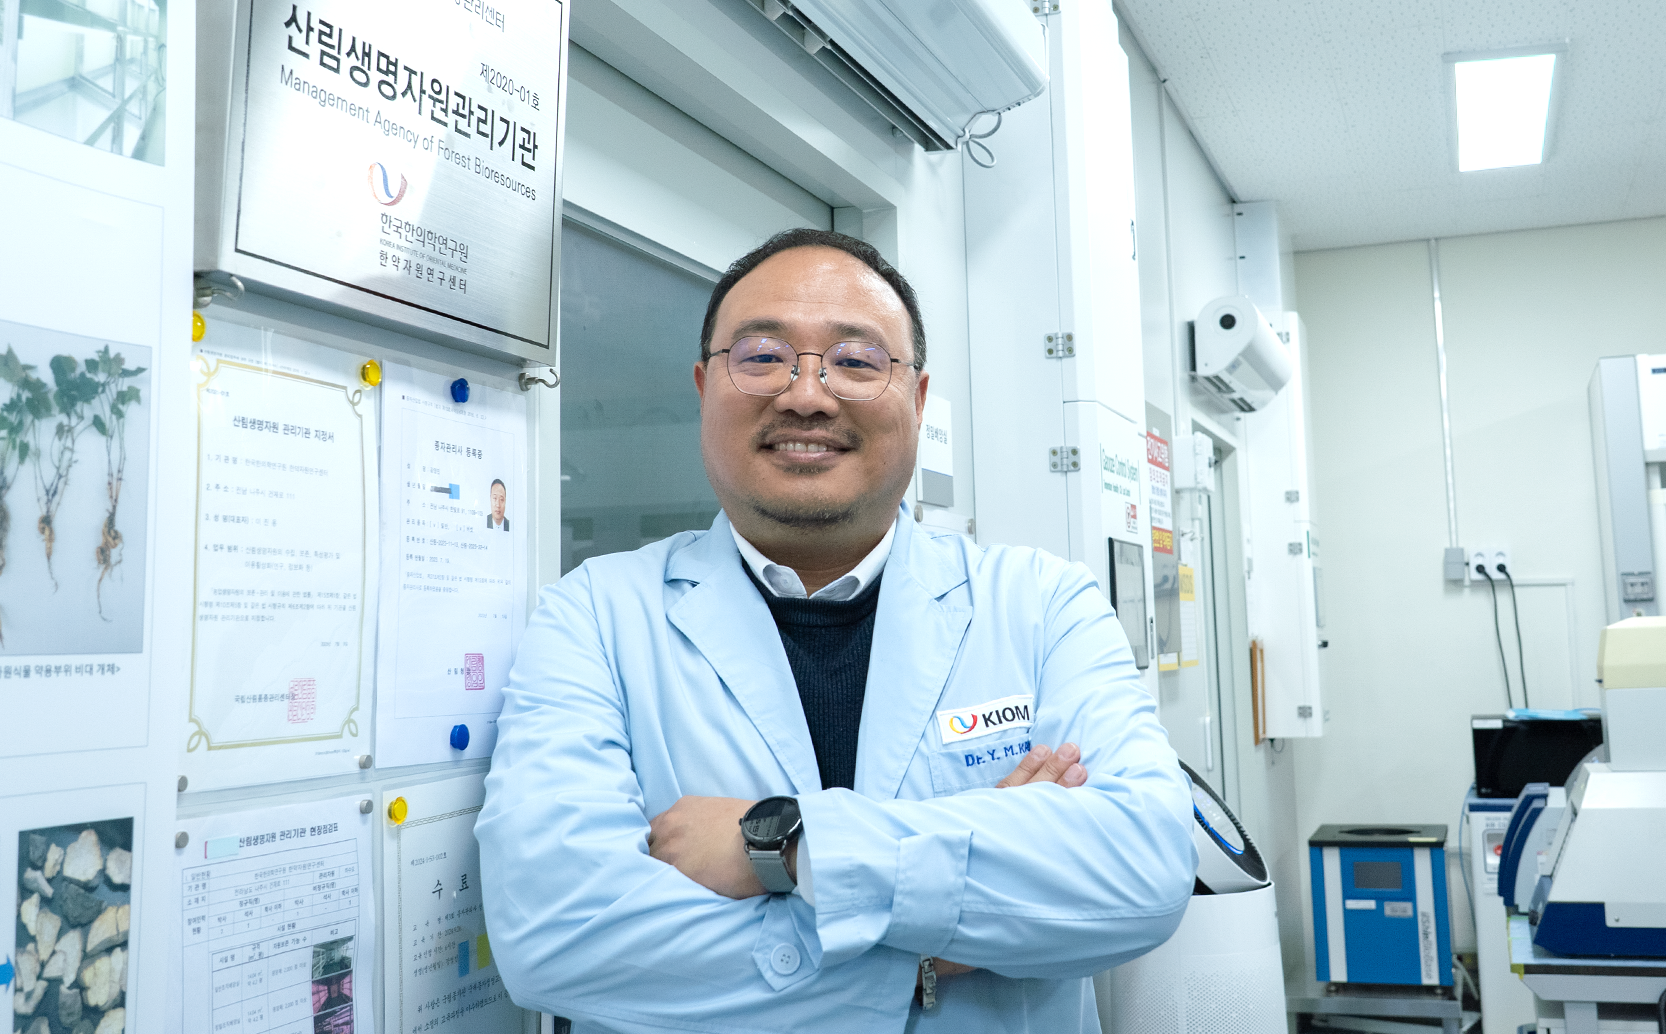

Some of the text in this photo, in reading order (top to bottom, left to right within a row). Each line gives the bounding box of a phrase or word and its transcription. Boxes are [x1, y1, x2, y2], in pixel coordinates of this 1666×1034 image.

[453, 0, 506, 33] 관리센터
[284, 4, 539, 171] 산림생명자원관리기관
[480, 62, 540, 111] 제2020-01호
[280, 65, 536, 201] Management Agency of Forest Bioresources
[381, 212, 469, 264] 한국한의학연구원
[380, 238, 468, 275] KOREA INSTITUTE OF ORIENTAL MEDICINE
[233, 415, 334, 444] 산림생명자원 관리기관 지정서
[0, 664, 30, 680] 원식물
[35, 663, 72, 679] 약용부위
[75, 664, 94, 678] 비대
[982, 705, 1030, 728] KIOM
[1004, 741, 1030, 758] M.KA
[239, 822, 338, 849] 산림생명자원 관리기관 현장점검표
